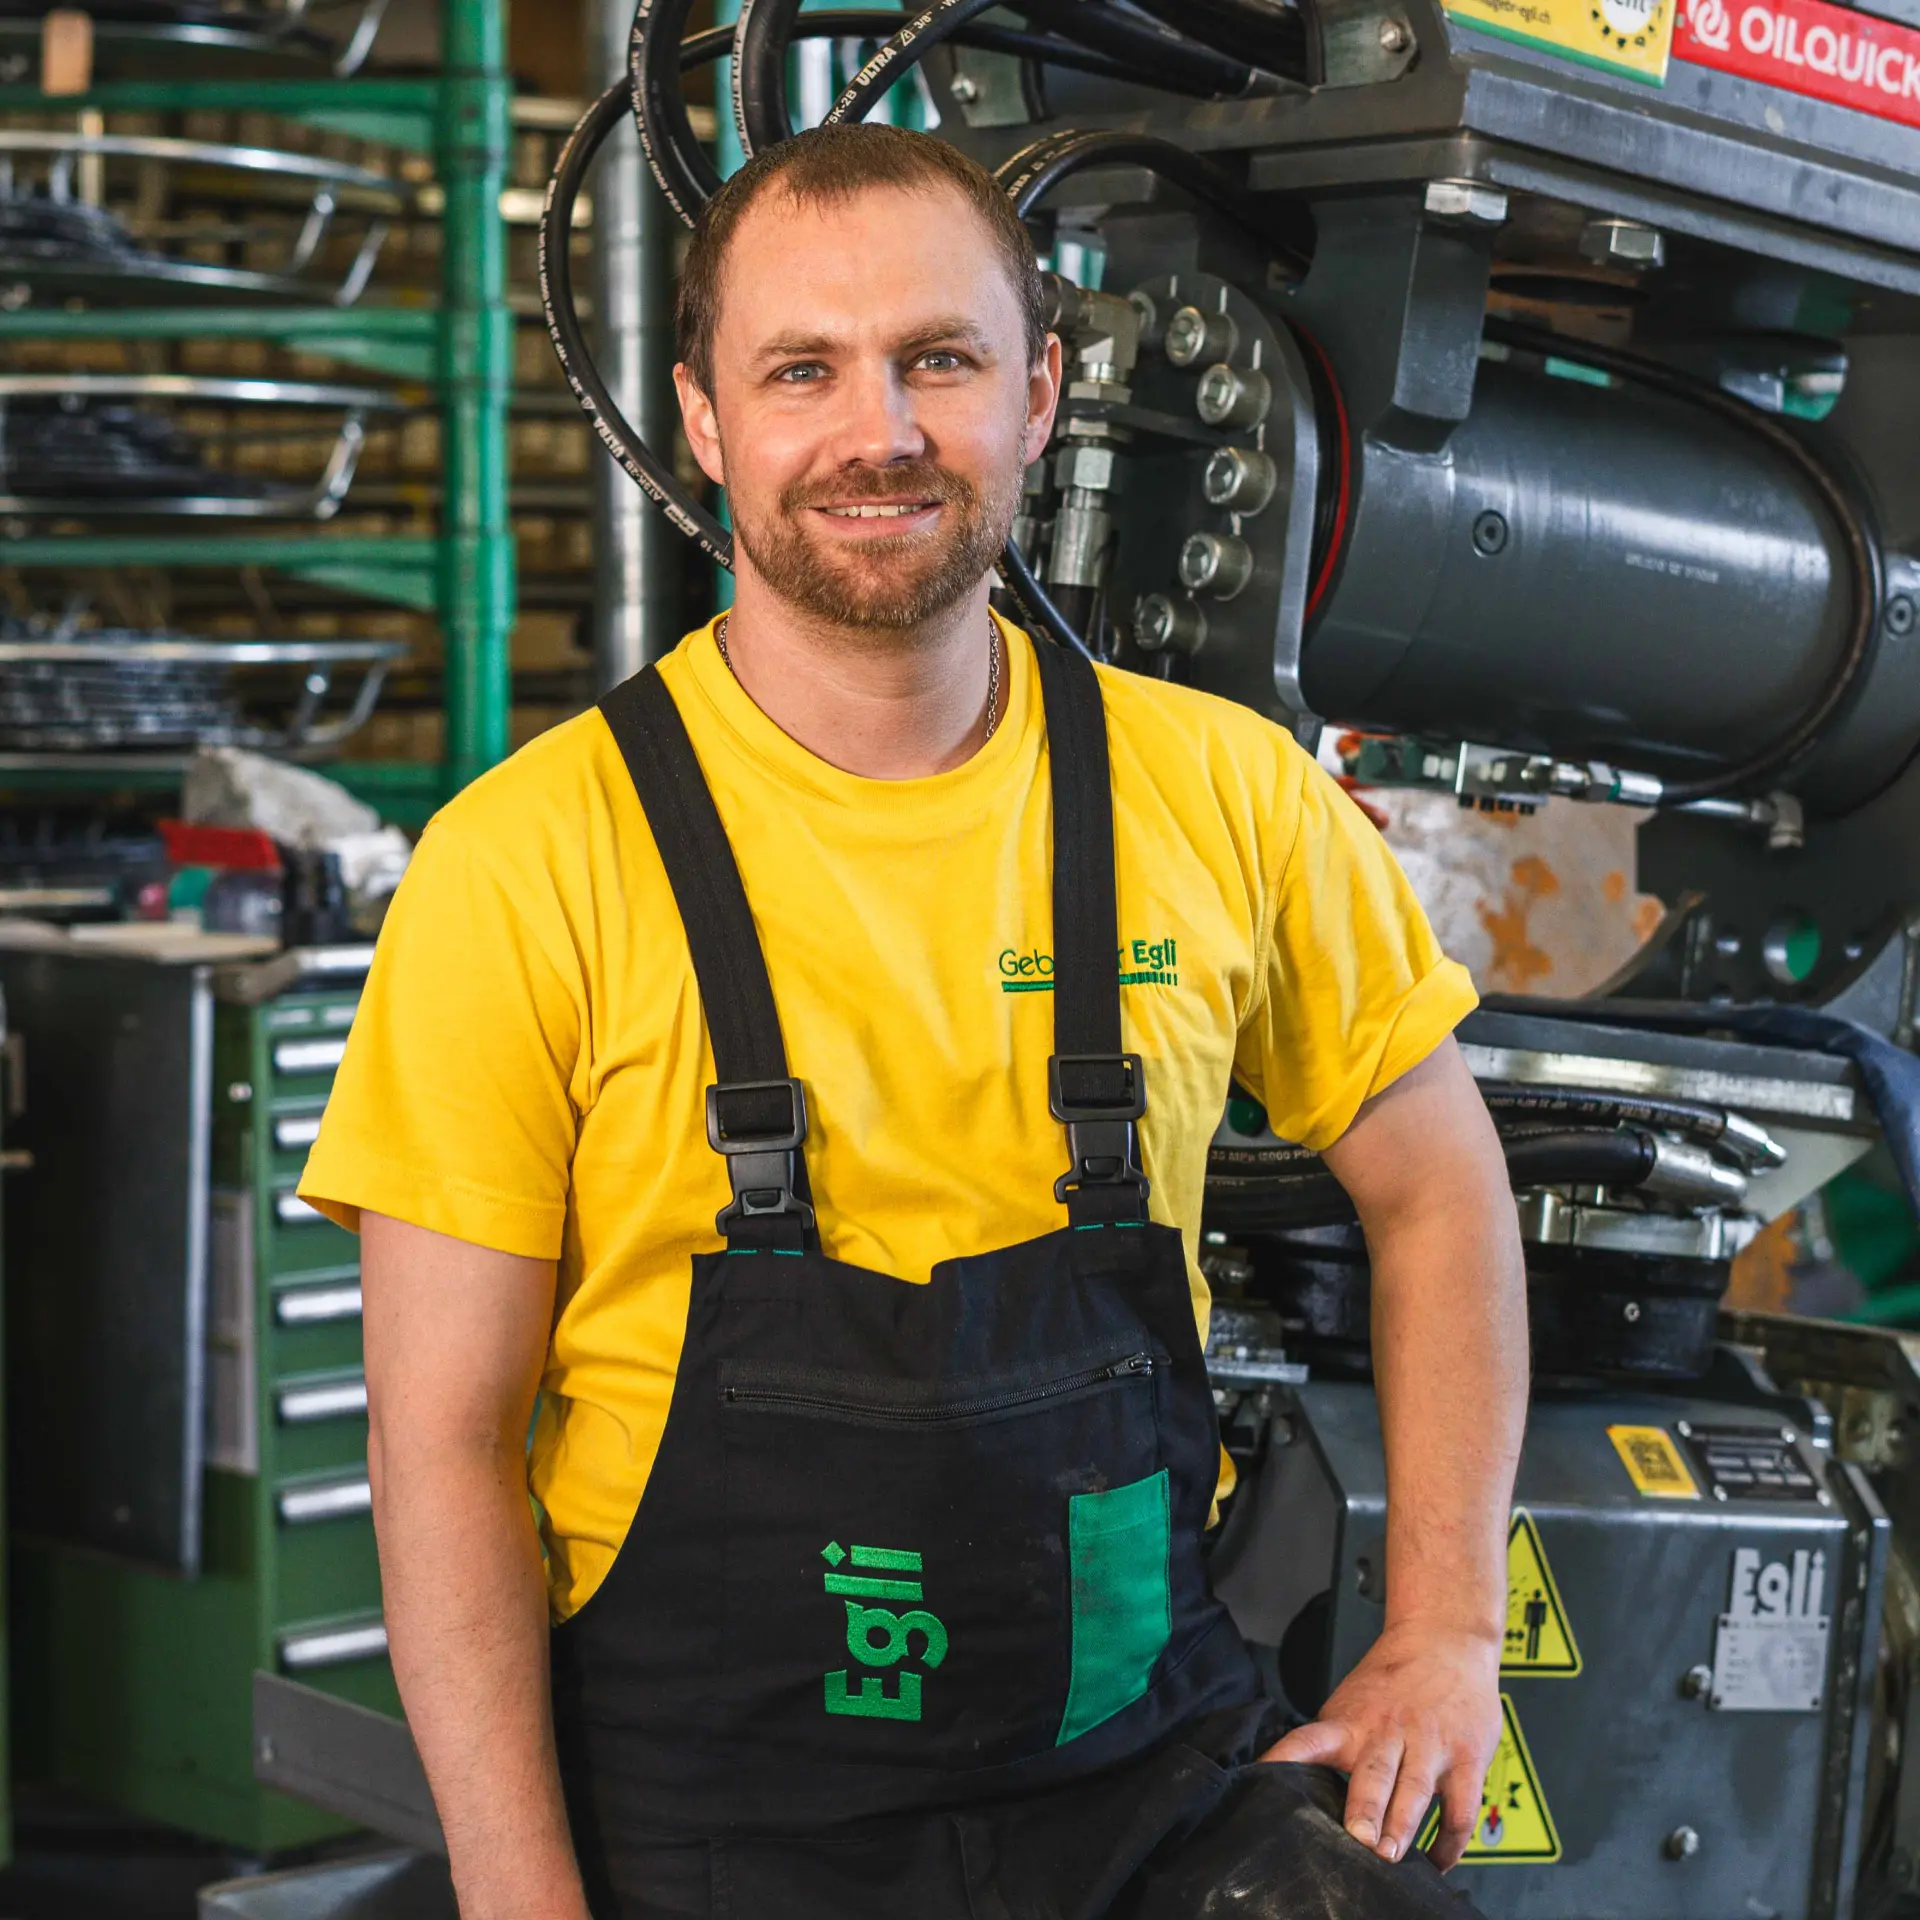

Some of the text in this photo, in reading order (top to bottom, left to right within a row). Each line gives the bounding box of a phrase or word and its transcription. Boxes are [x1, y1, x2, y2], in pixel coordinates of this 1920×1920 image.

[856, 46, 898, 87] ULTRA
[1739, 5, 1920, 103] OILQUICK
[593, 416, 626, 458] ULTRA
[1131, 938, 1177, 970] Egli
[1731, 1547, 1825, 1617] Egli
[820, 1540, 949, 1721] Egli
